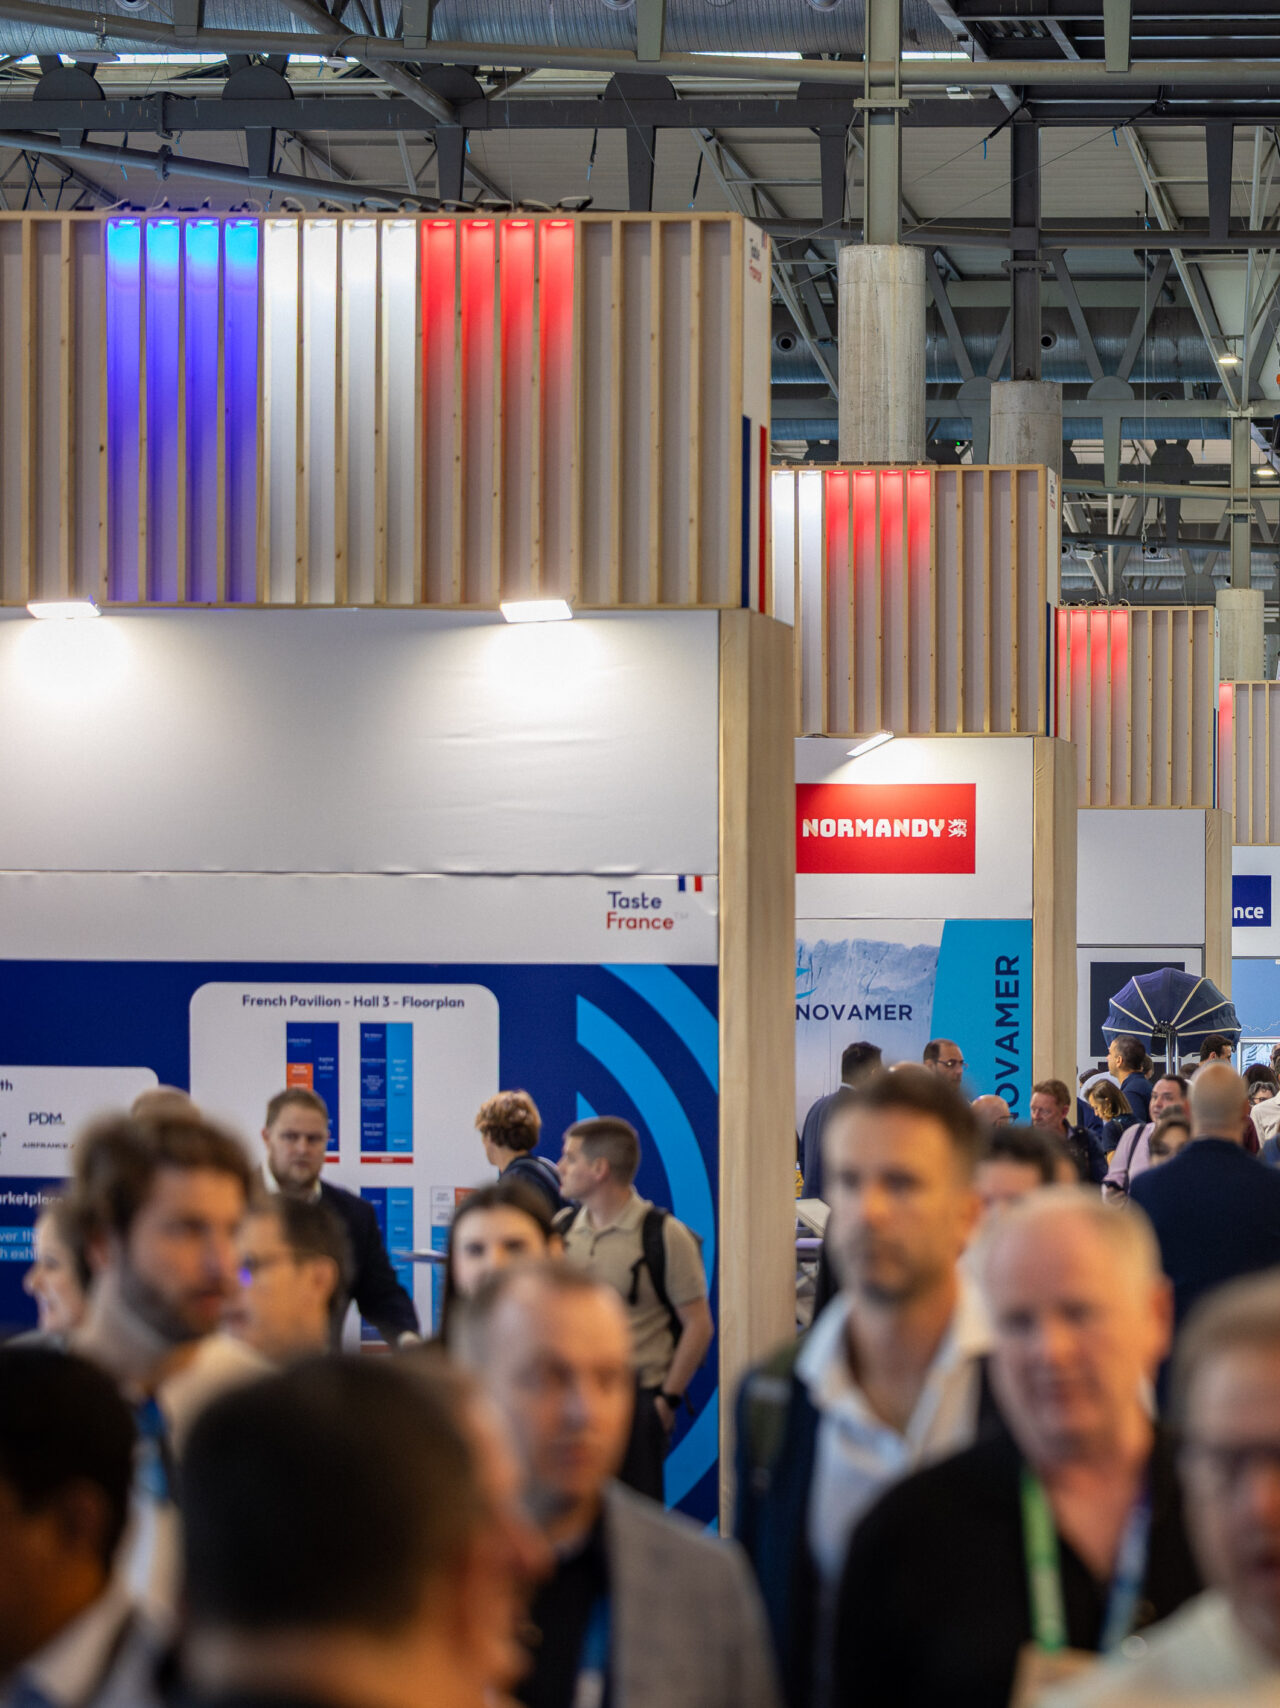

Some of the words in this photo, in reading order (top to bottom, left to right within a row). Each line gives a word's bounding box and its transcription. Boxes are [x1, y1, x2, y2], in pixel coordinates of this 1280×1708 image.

[802, 818, 945, 838] NORMANDY
[607, 890, 662, 909] Taste
[606, 911, 674, 930] France
[1232, 906, 1264, 919] nce
[242, 994, 287, 1007] French
[290, 995, 341, 1007] Pavilion
[353, 995, 379, 1007] Hall
[382, 995, 390, 1007] 3
[402, 996, 465, 1011] Floorplan
[796, 1004, 913, 1021] NOVAMER
[995, 955, 1020, 1114] OVAMER
[28, 1112, 62, 1125] PDM
